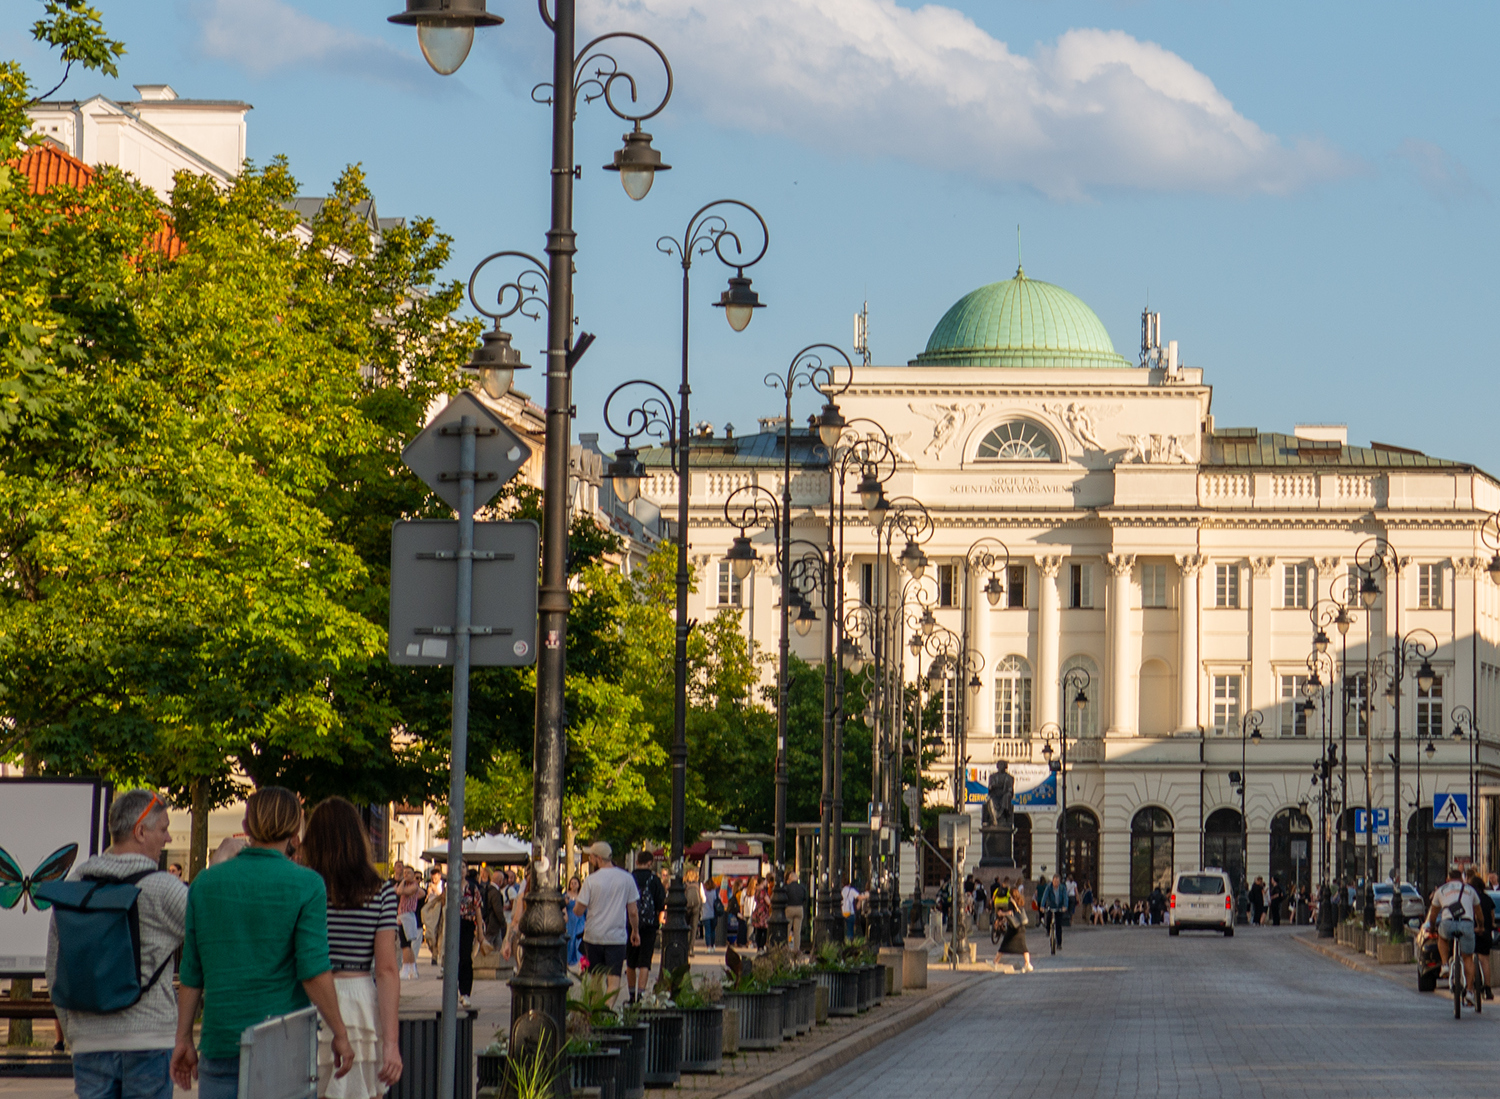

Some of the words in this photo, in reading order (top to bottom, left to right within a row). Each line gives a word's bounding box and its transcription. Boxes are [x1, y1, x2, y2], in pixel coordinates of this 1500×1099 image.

[991, 476, 1040, 485] SOCIETAS
[949, 485, 1014, 494] SCIENTIARVM
[969, 793, 988, 803] CZERWC
